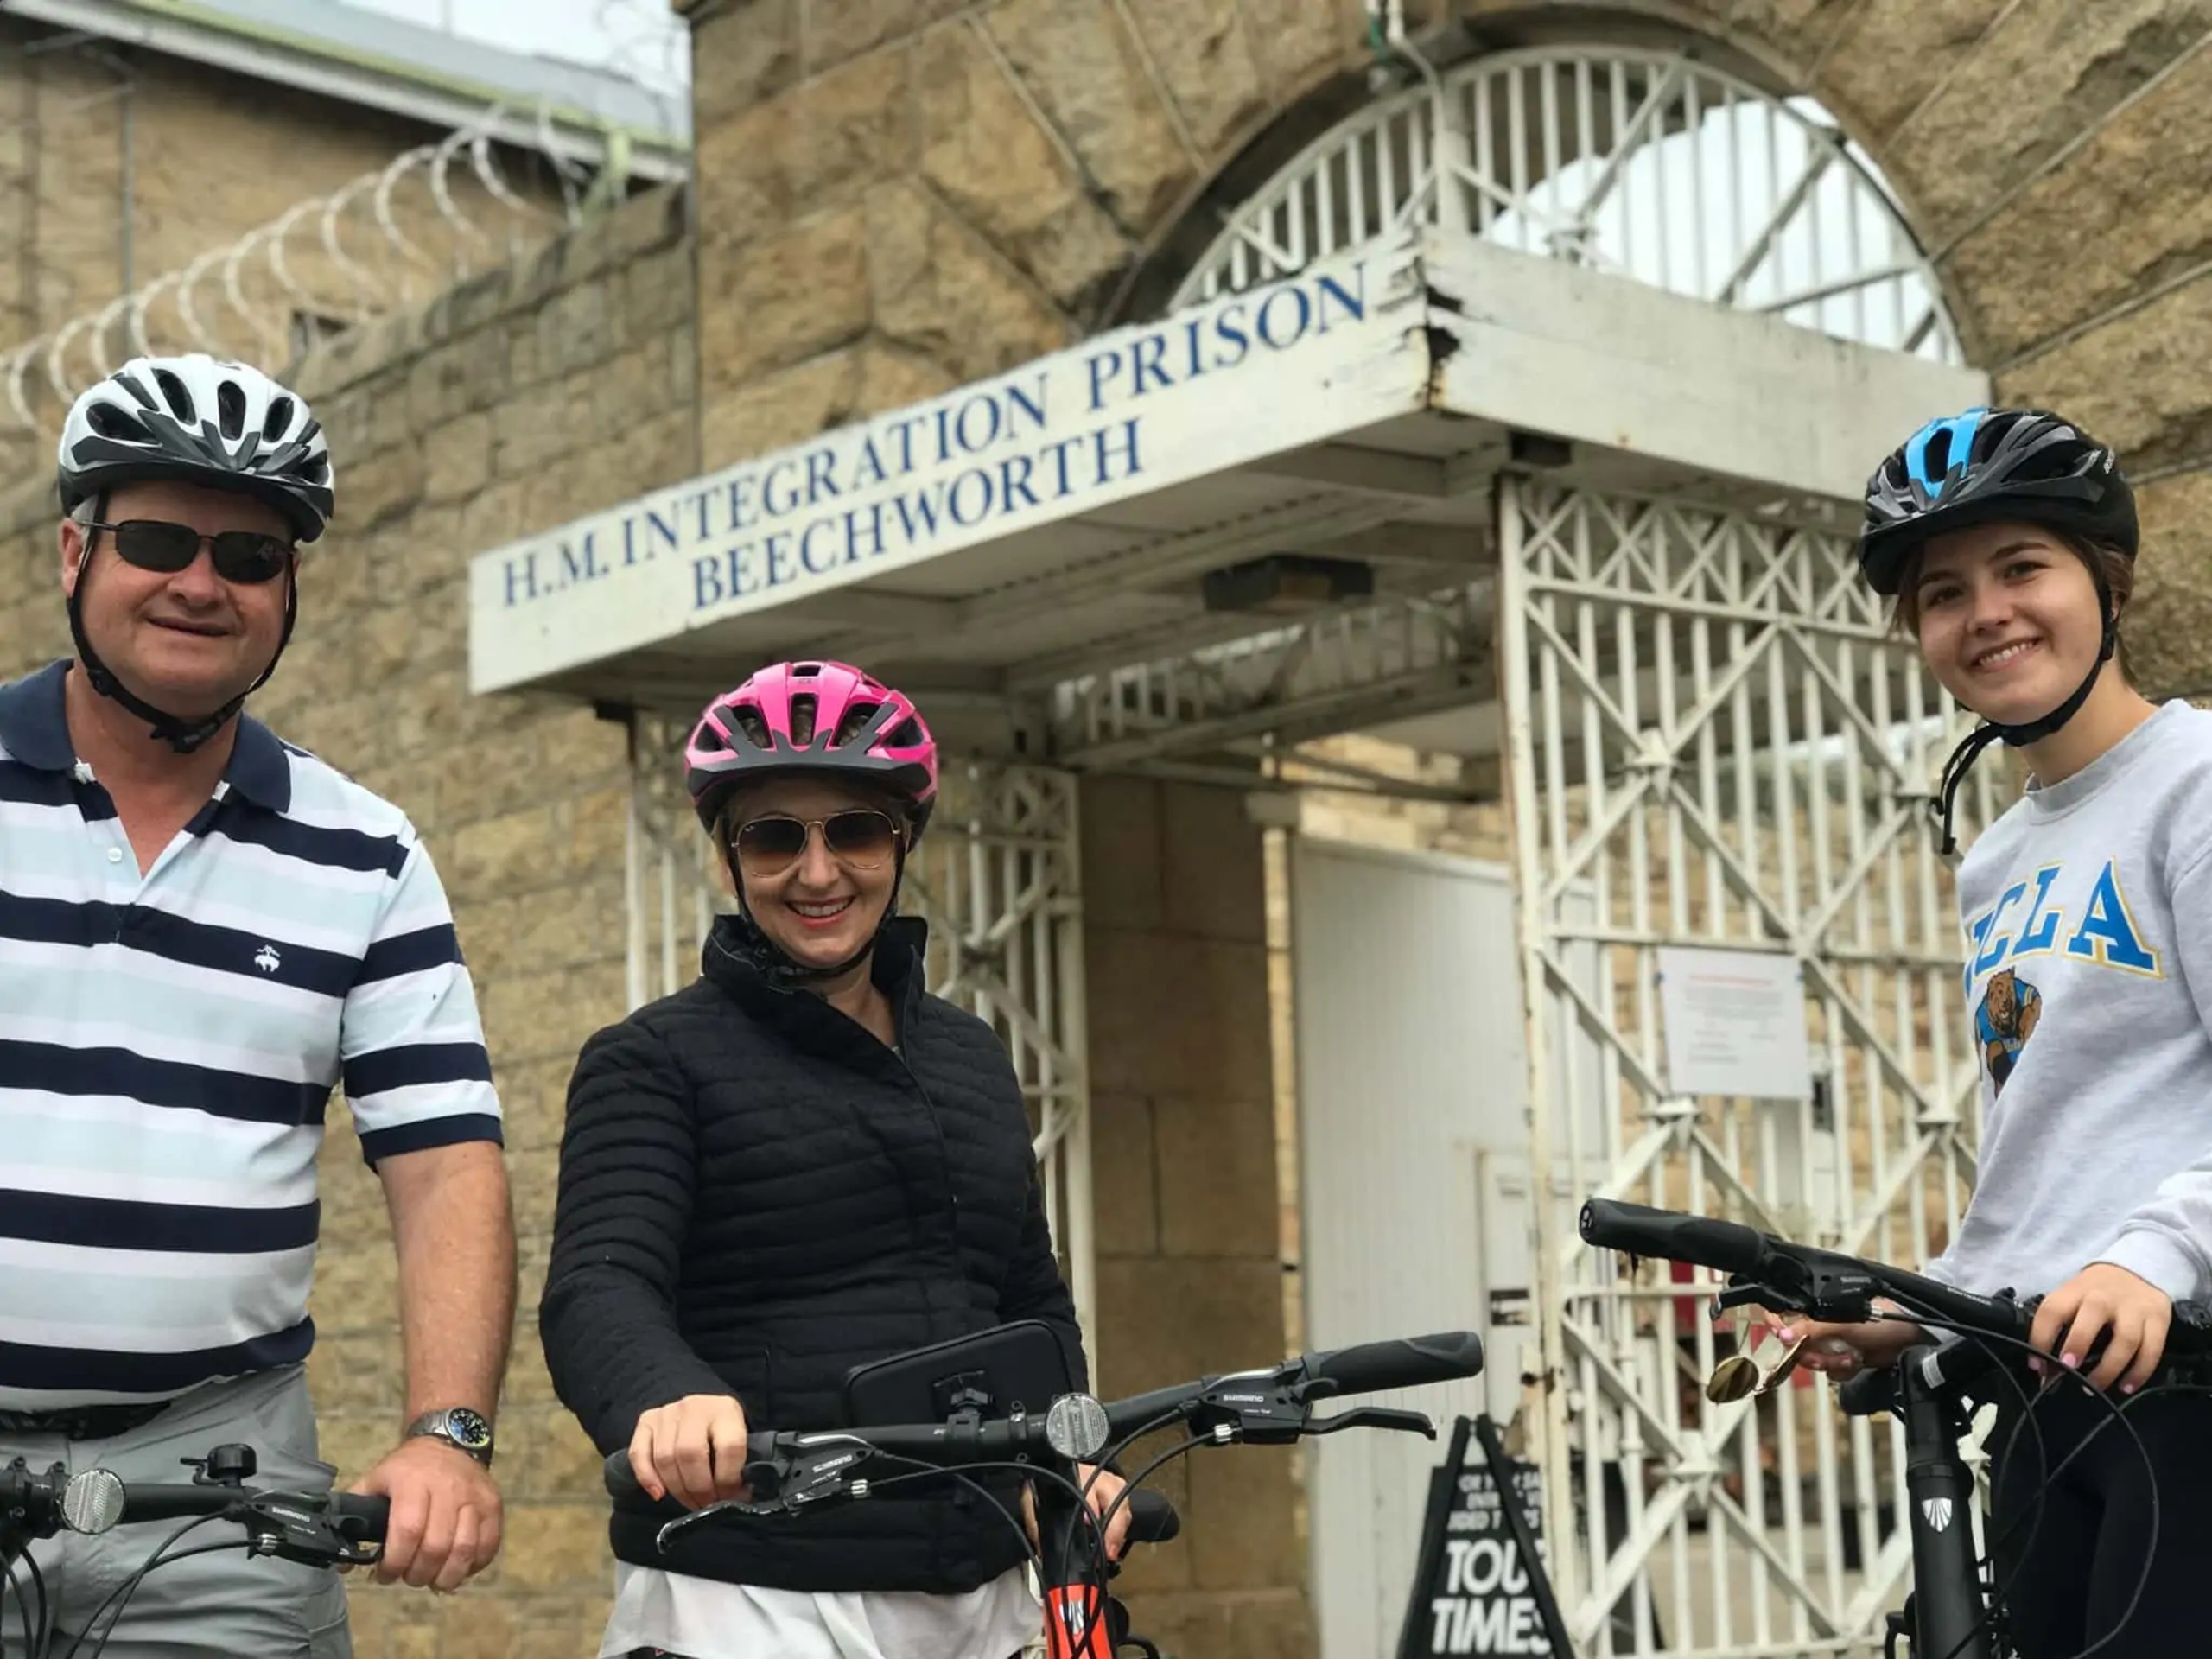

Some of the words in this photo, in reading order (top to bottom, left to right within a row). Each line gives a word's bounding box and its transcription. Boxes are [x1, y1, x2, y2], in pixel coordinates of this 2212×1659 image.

[1084, 261, 1367, 413] PRISON
[692, 416, 1147, 610] BEECHWORTH
[1446, 1538, 1529, 1595] TOU
